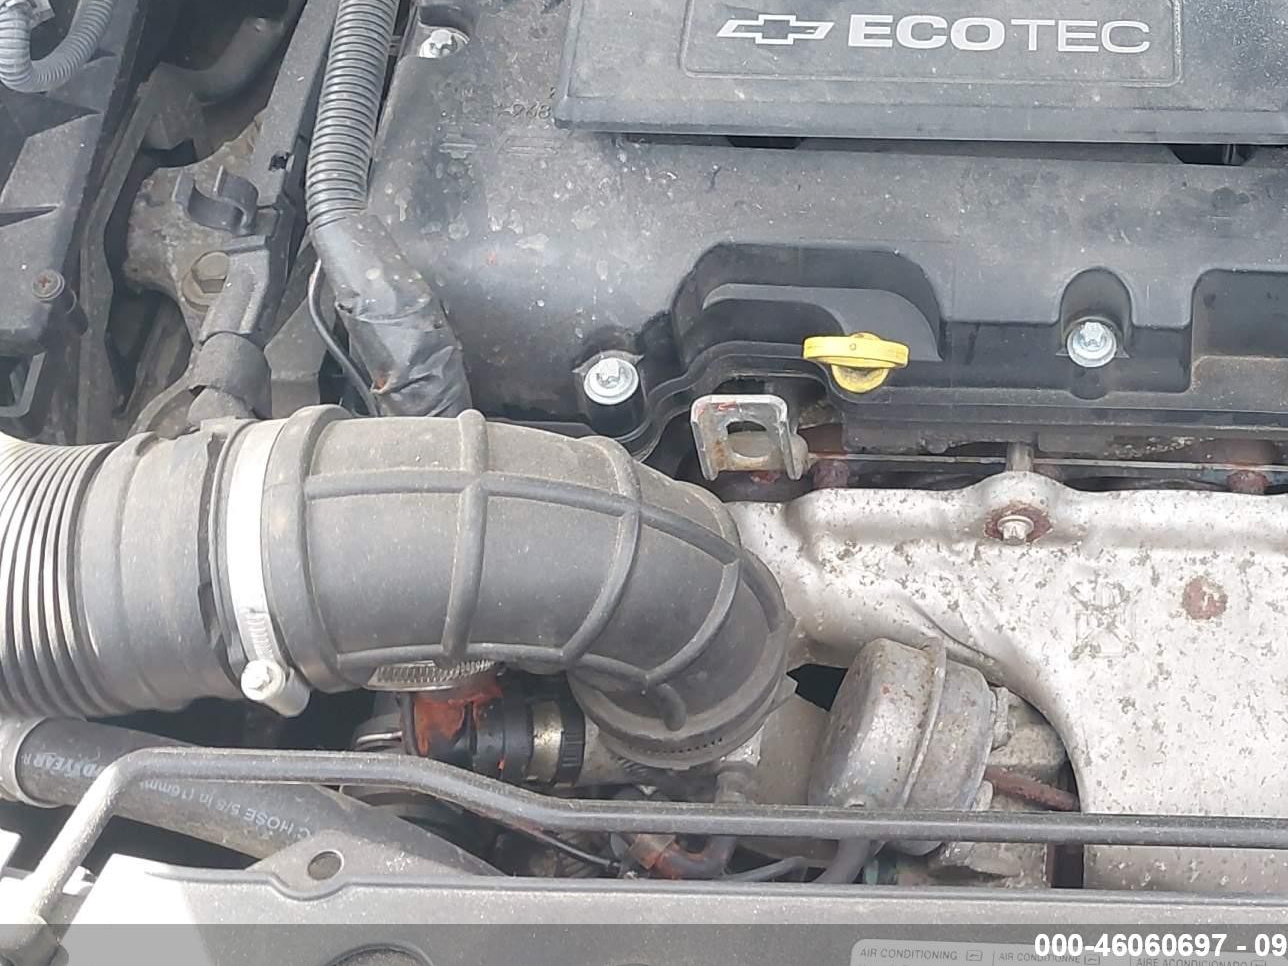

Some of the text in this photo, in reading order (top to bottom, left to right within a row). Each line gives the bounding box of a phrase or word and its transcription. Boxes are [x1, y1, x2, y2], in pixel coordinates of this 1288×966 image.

[847, 13, 1152, 54] ECOTEC
[243, 808, 294, 834] HOSE
[859, 948, 958, 961] AIR CONDITIONING
[999, 952, 1015, 962] AIR
